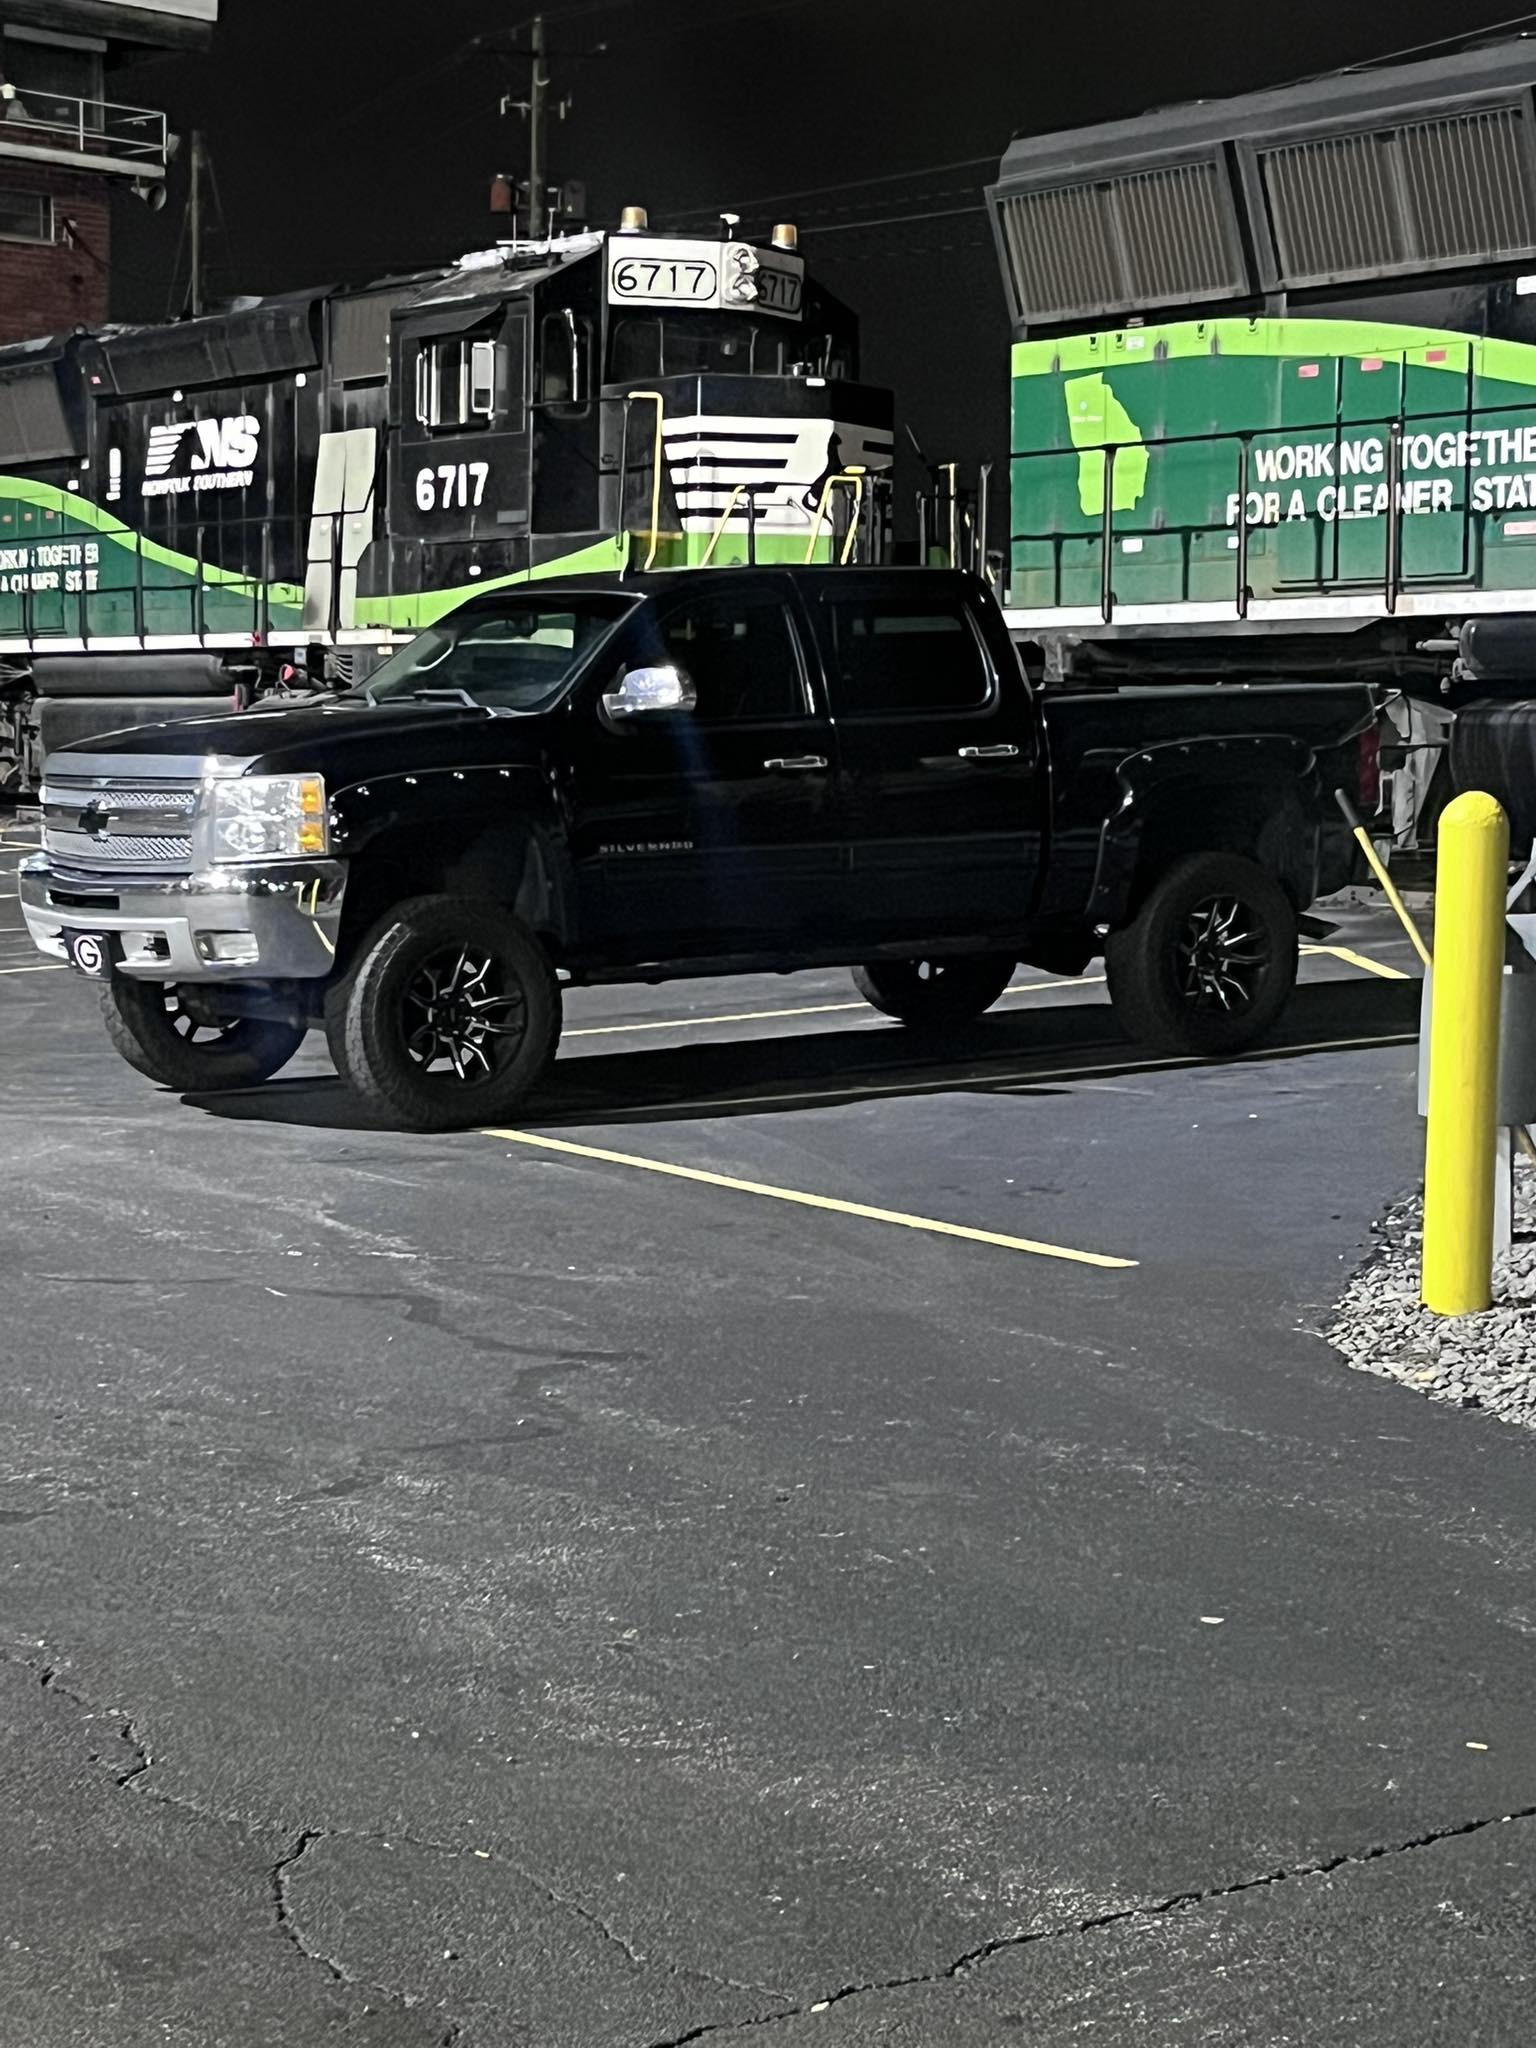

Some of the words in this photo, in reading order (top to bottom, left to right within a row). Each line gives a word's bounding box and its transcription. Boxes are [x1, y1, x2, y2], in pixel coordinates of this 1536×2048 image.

[618, 264, 706, 293] 6717
[191, 415, 260, 470] NS
[1255, 438, 1384, 482] WORKNG
[416, 462, 489, 511] 6717
[1226, 491, 1280, 525] FOR
[1286, 489, 1307, 522] A
[1316, 478, 1453, 521] CLEANER
